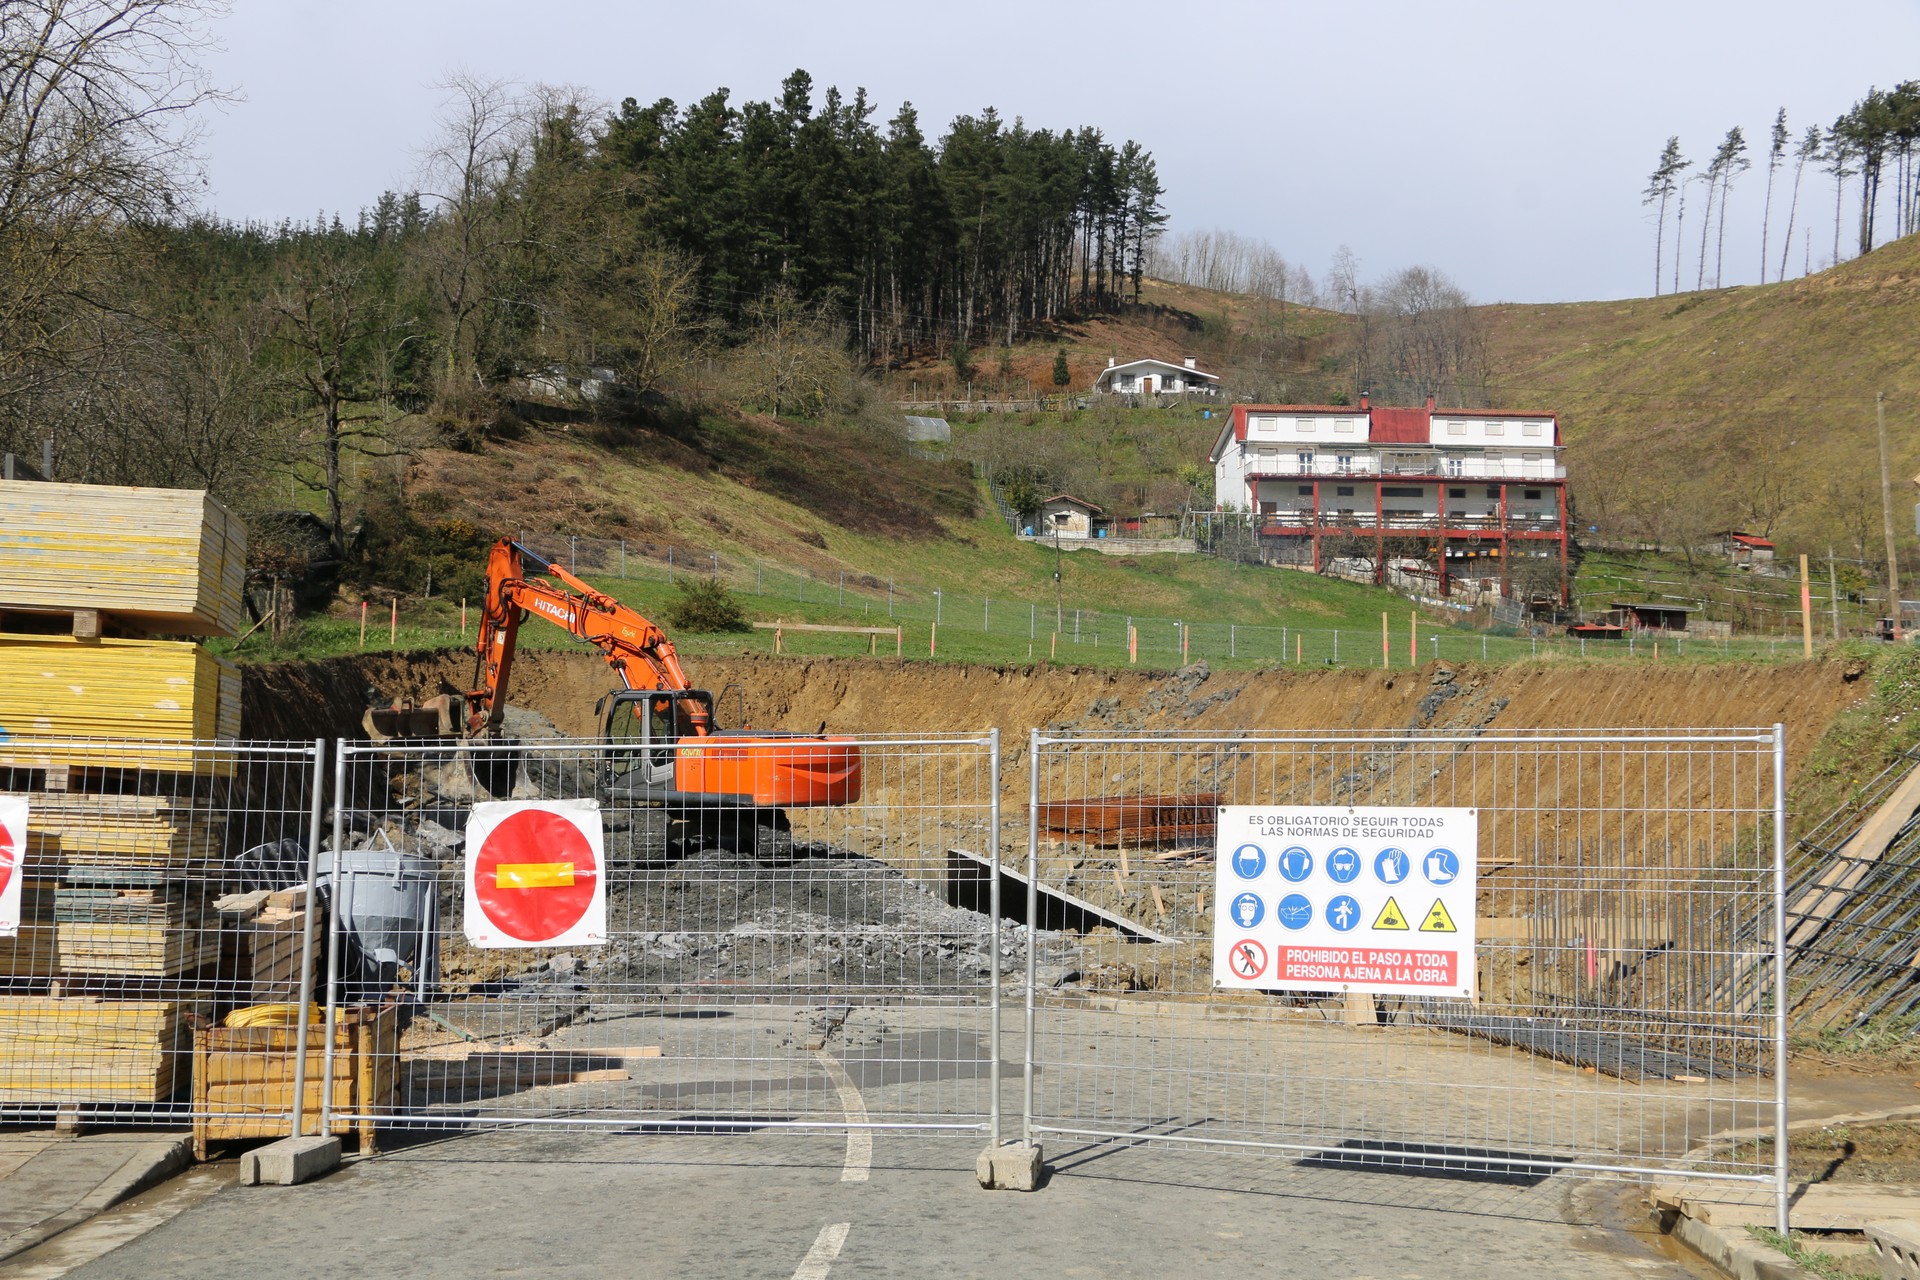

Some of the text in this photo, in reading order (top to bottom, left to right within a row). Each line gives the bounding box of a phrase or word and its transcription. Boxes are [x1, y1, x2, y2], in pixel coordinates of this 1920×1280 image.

[534, 598, 576, 623] HITACHI
[1249, 815, 1444, 827] ES OBLIGATORIO SEGUIR TODAS
[1261, 827, 1434, 838] LAS NORMAS DE SEGURIDAD
[1287, 949, 1448, 967] PROHIBIDO EL PASO A TODA
[1286, 964, 1448, 983] PERSONA AJENA A LA OBRA
